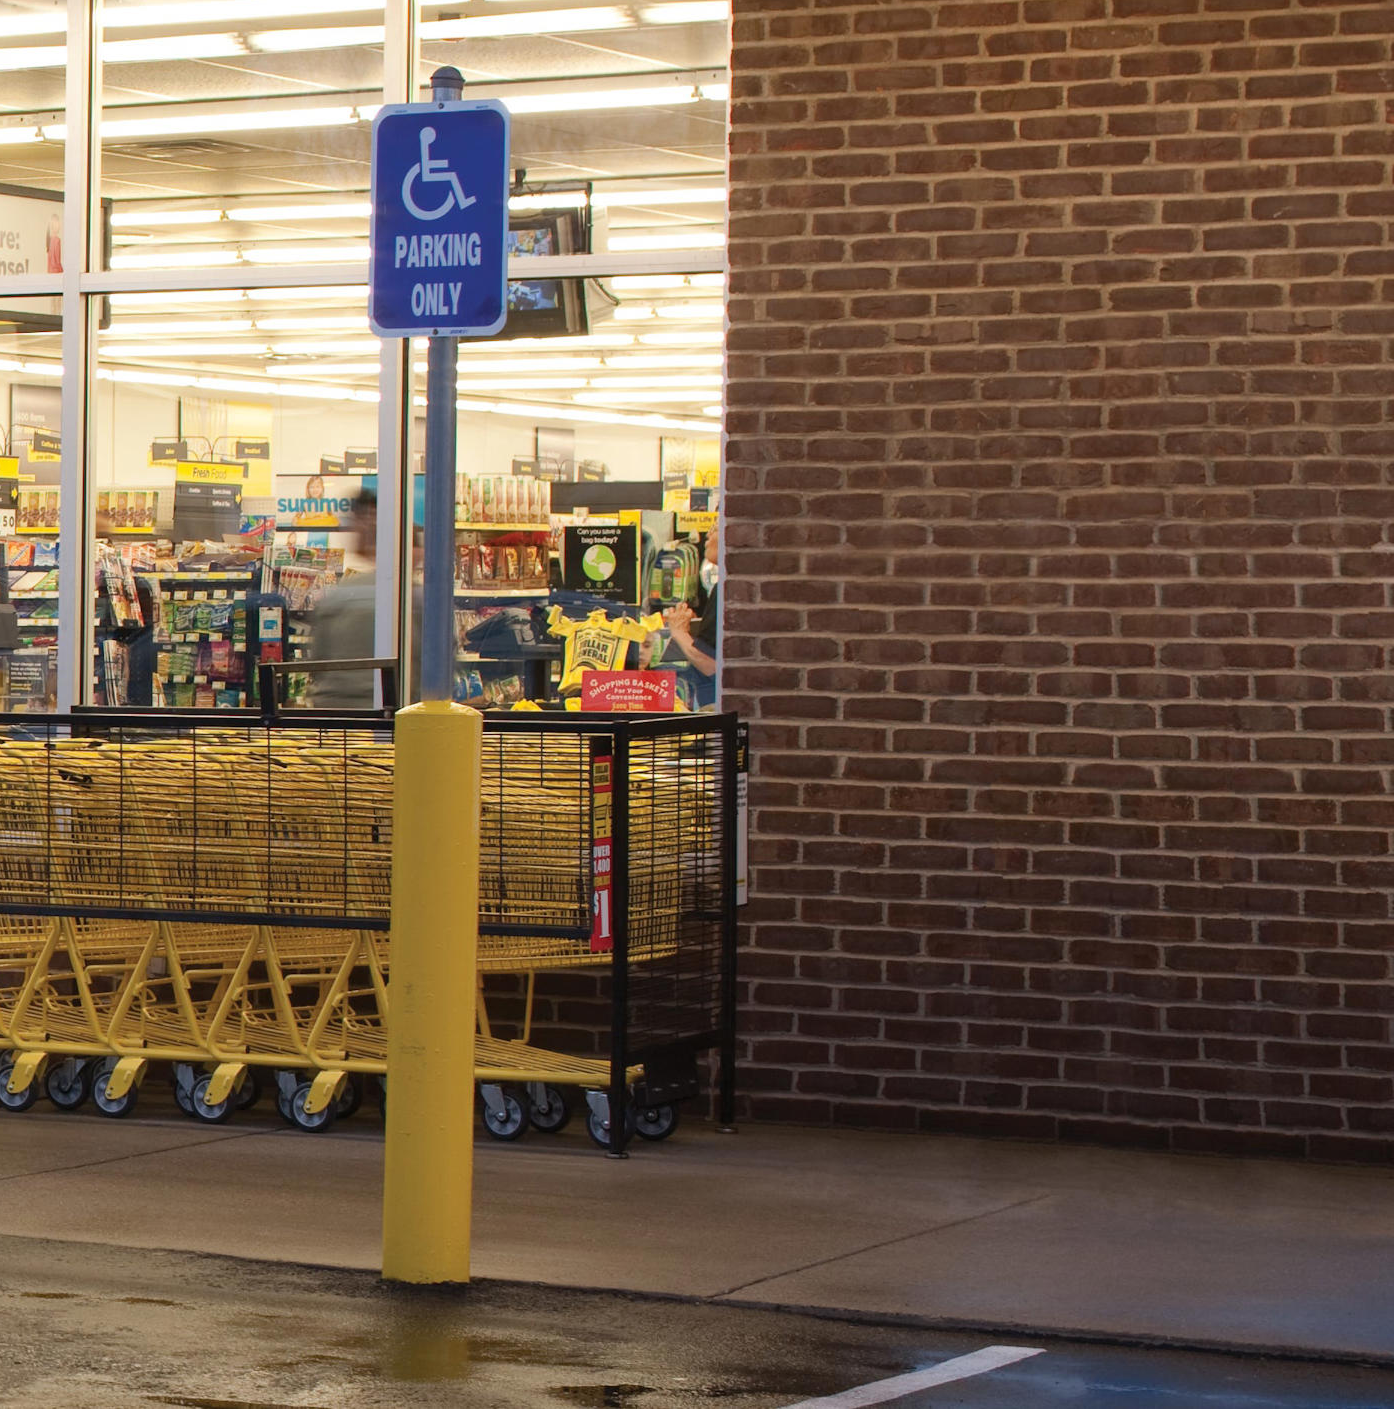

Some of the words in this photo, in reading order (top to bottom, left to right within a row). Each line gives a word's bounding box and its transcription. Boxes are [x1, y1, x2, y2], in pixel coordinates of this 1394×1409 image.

[394, 232, 482, 269] PARKING
[411, 282, 463, 317] ONLY
[192, 467, 210, 479] Fresh
[210, 468, 227, 480] Food
[594, 536, 618, 545] today?
[589, 678, 630, 699] SHOPPING
[632, 678, 669, 699] BASKETS
[627, 687, 644, 695] Your
[593, 844, 610, 858] OVER
